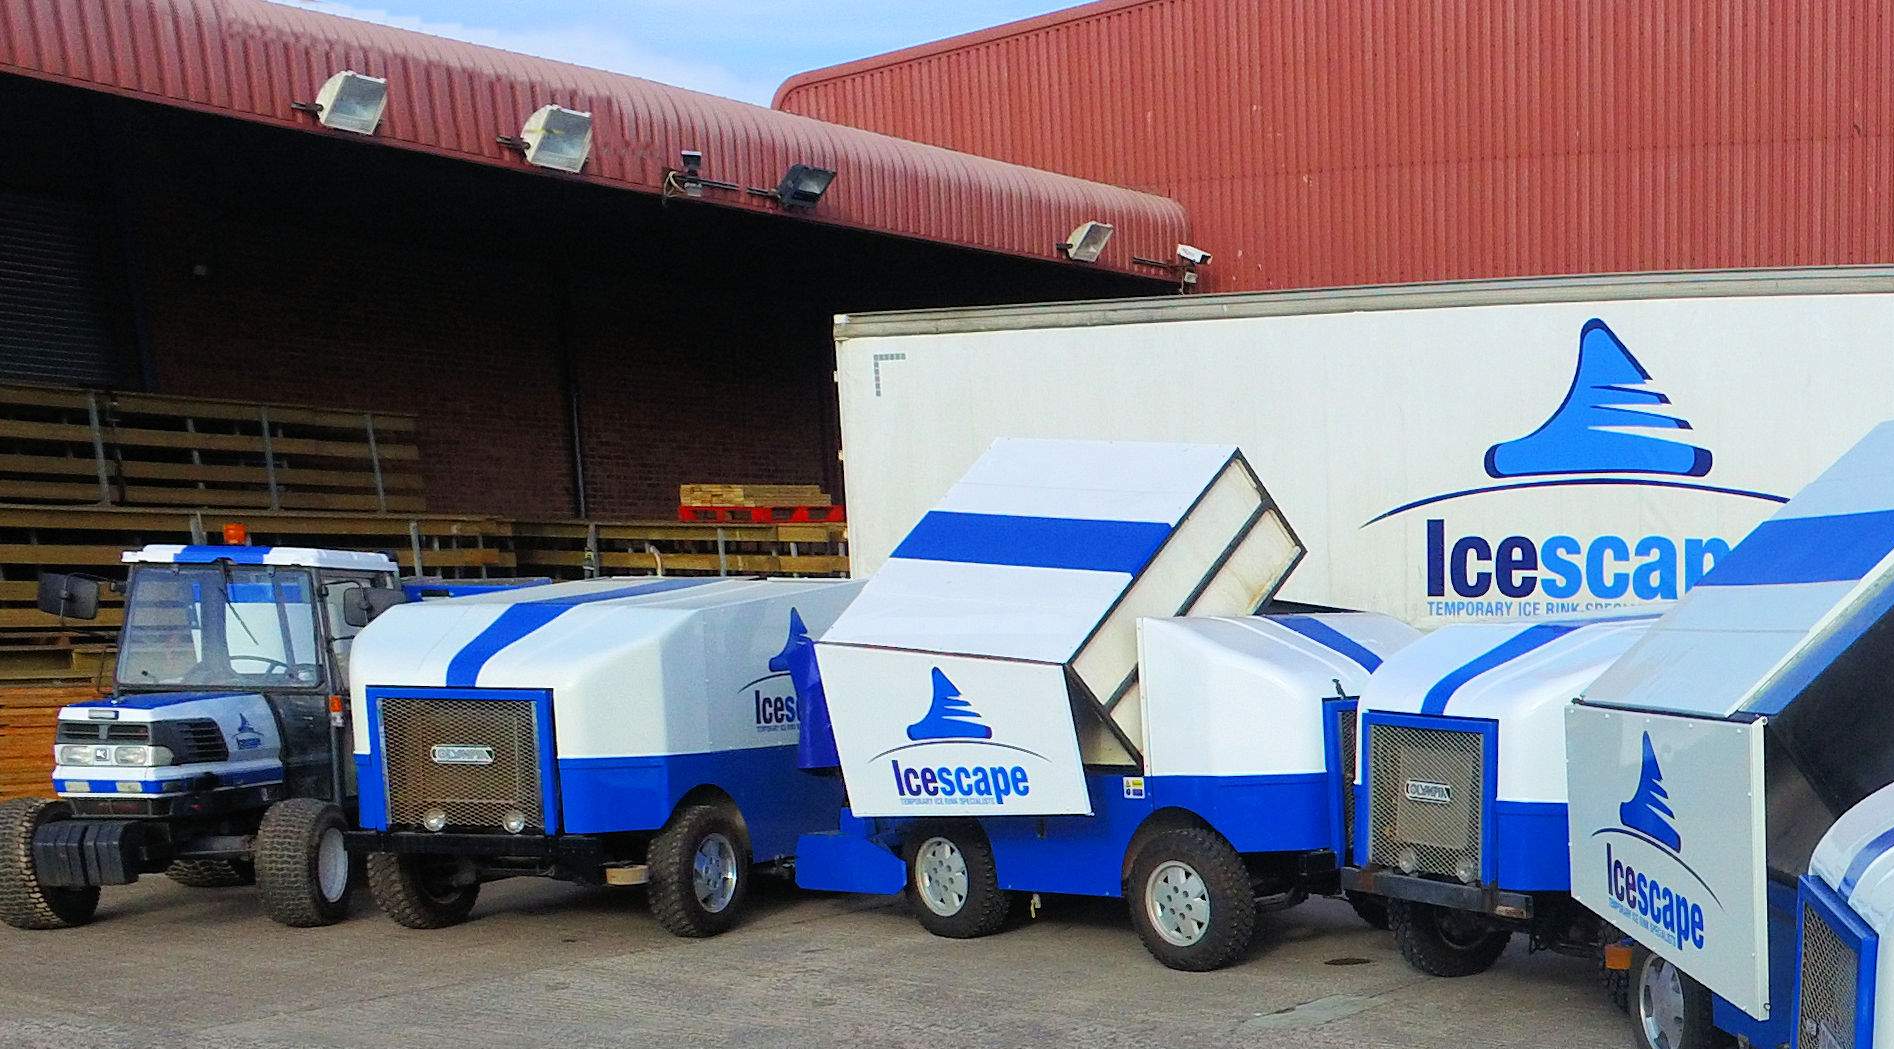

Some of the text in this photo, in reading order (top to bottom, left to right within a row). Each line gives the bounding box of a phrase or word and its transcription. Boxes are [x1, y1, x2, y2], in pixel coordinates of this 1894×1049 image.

[1427, 519, 1730, 600] Icescap
[1427, 602, 1513, 617] TEMPORARY
[1519, 602, 1540, 616] ICE
[755, 690, 797, 724] Ices
[892, 760, 1029, 804] Icescape
[1607, 842, 1704, 950] Icescape
